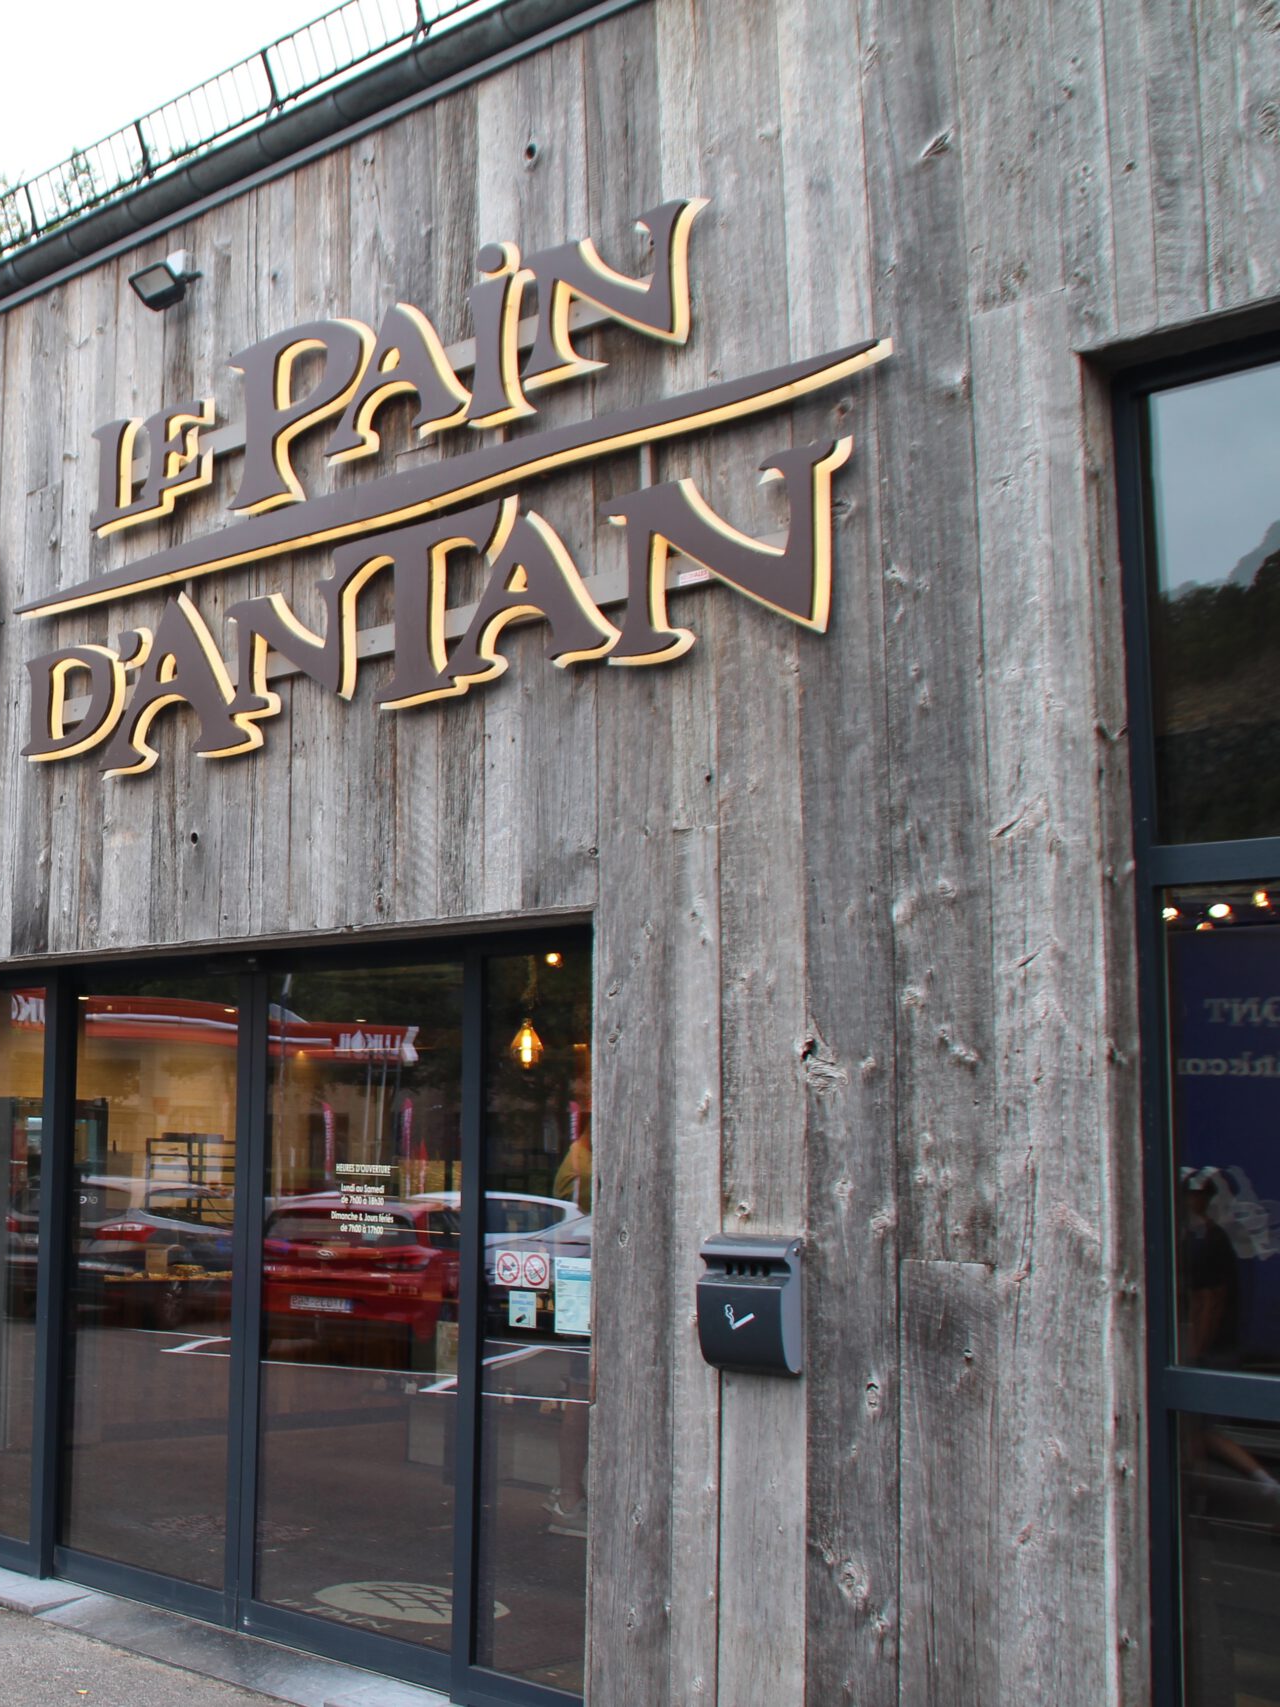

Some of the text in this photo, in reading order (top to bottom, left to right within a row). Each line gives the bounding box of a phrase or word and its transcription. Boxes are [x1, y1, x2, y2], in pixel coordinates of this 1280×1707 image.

[92, 398, 216, 538] LE
[22, 435, 854, 780] D'ANTAN
[336, 1164, 391, 1173] HEURES D'OUVERTURE
[341, 1184, 355, 1192] Lundi
[364, 1185, 384, 1193] Samedi
[331, 1211, 358, 1220] Dimanche
